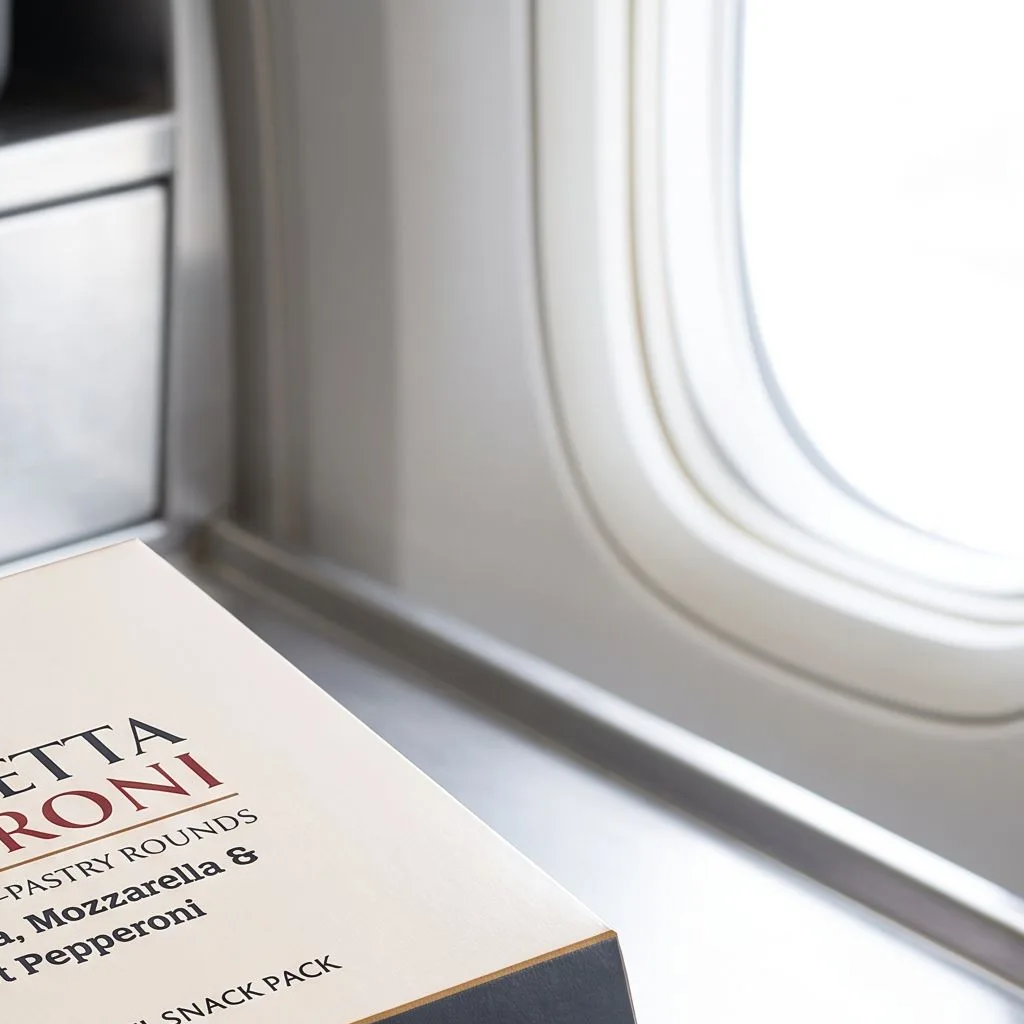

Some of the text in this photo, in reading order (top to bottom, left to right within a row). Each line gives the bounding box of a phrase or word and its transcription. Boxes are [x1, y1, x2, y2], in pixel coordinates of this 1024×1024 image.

[119, 809, 257, 862] ROUNDS
[23, 862, 224, 934] Mozzarella
[227, 847, 258, 865] &
[16, 899, 207, 975] Pepperoni
[262, 955, 342, 991] PACK
